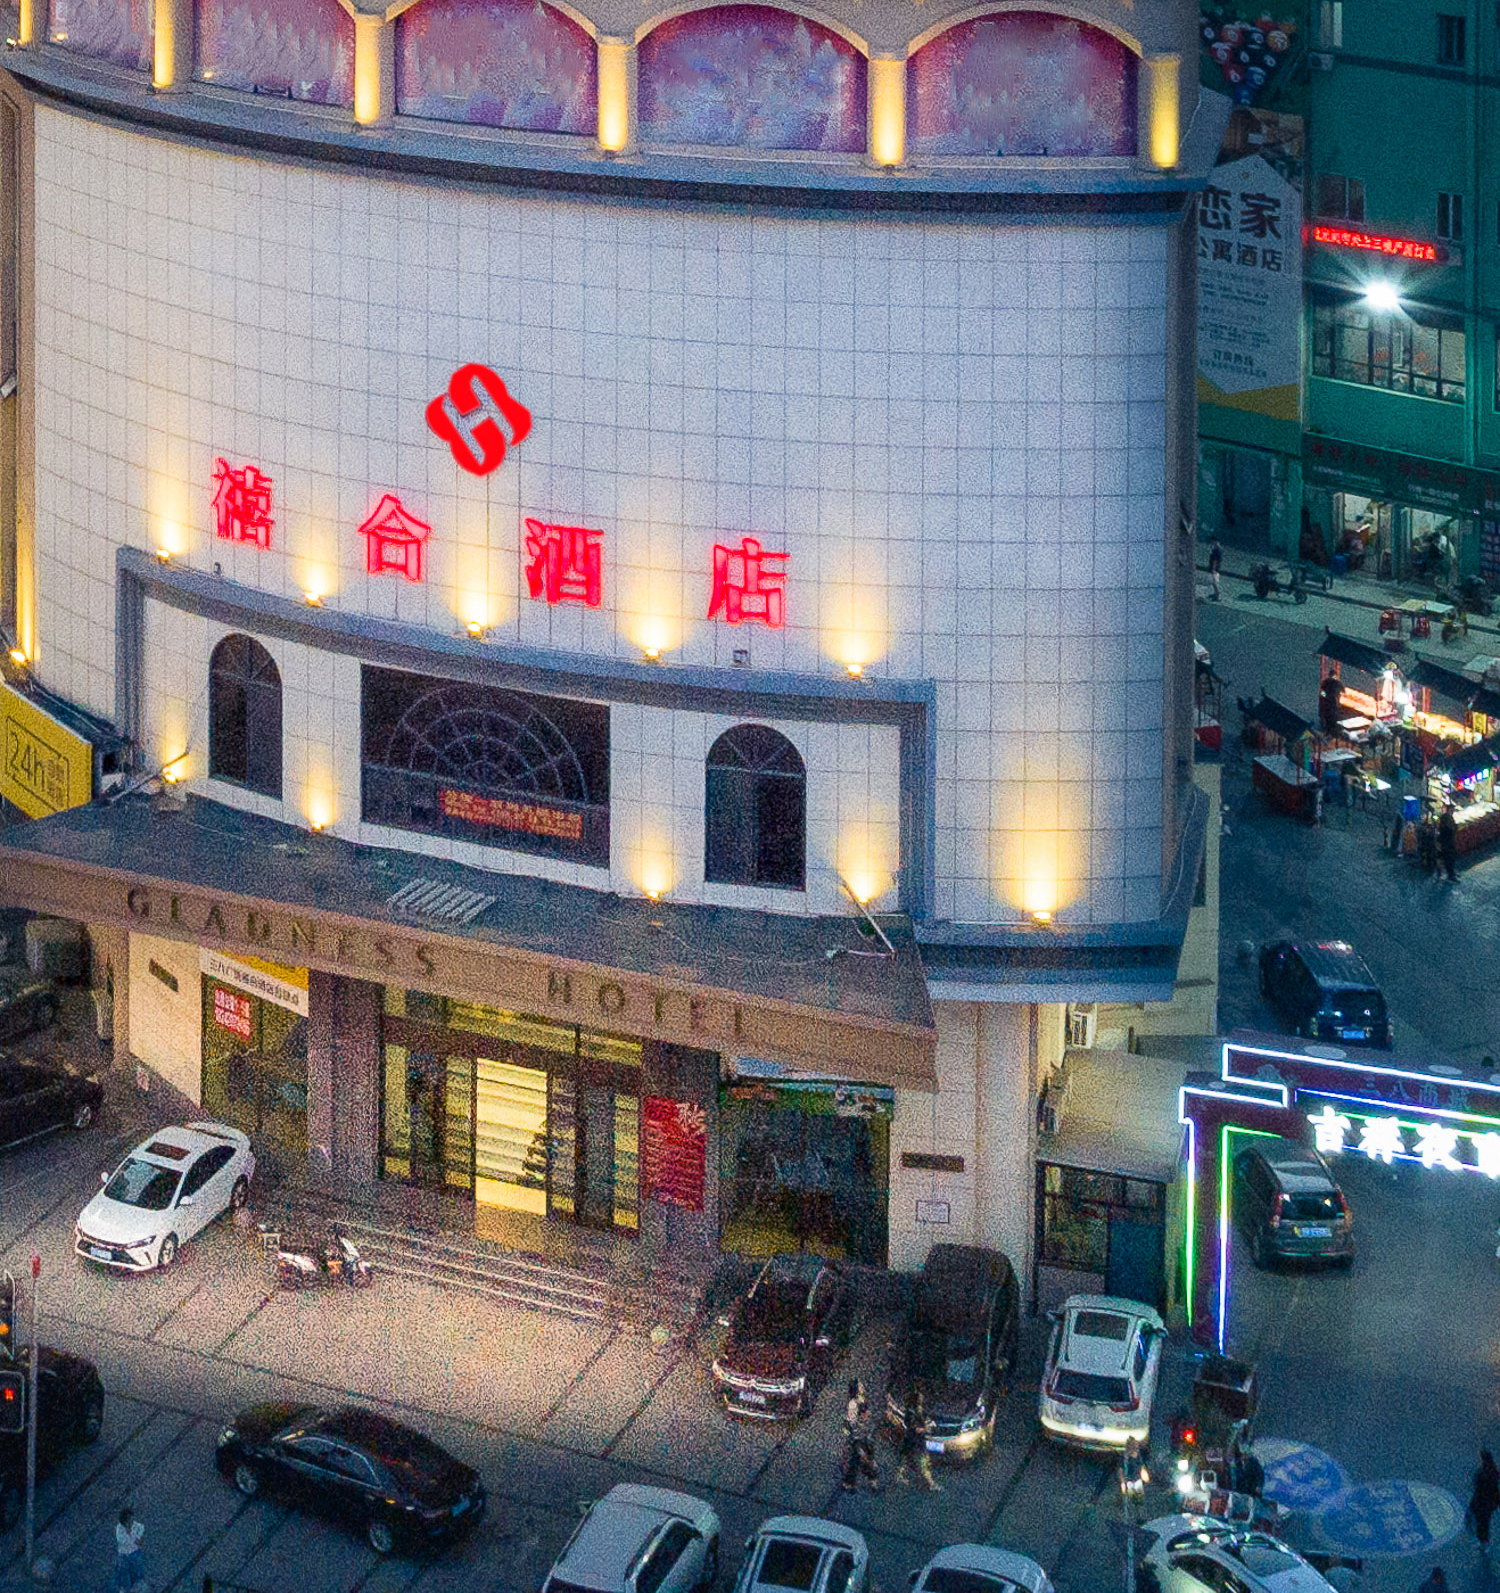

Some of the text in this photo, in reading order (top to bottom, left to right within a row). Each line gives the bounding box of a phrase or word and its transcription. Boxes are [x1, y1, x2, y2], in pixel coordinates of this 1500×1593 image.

[212, 457, 791, 628] 禧合酒店
[127, 884, 747, 1036] GLADNESS HOTEL
